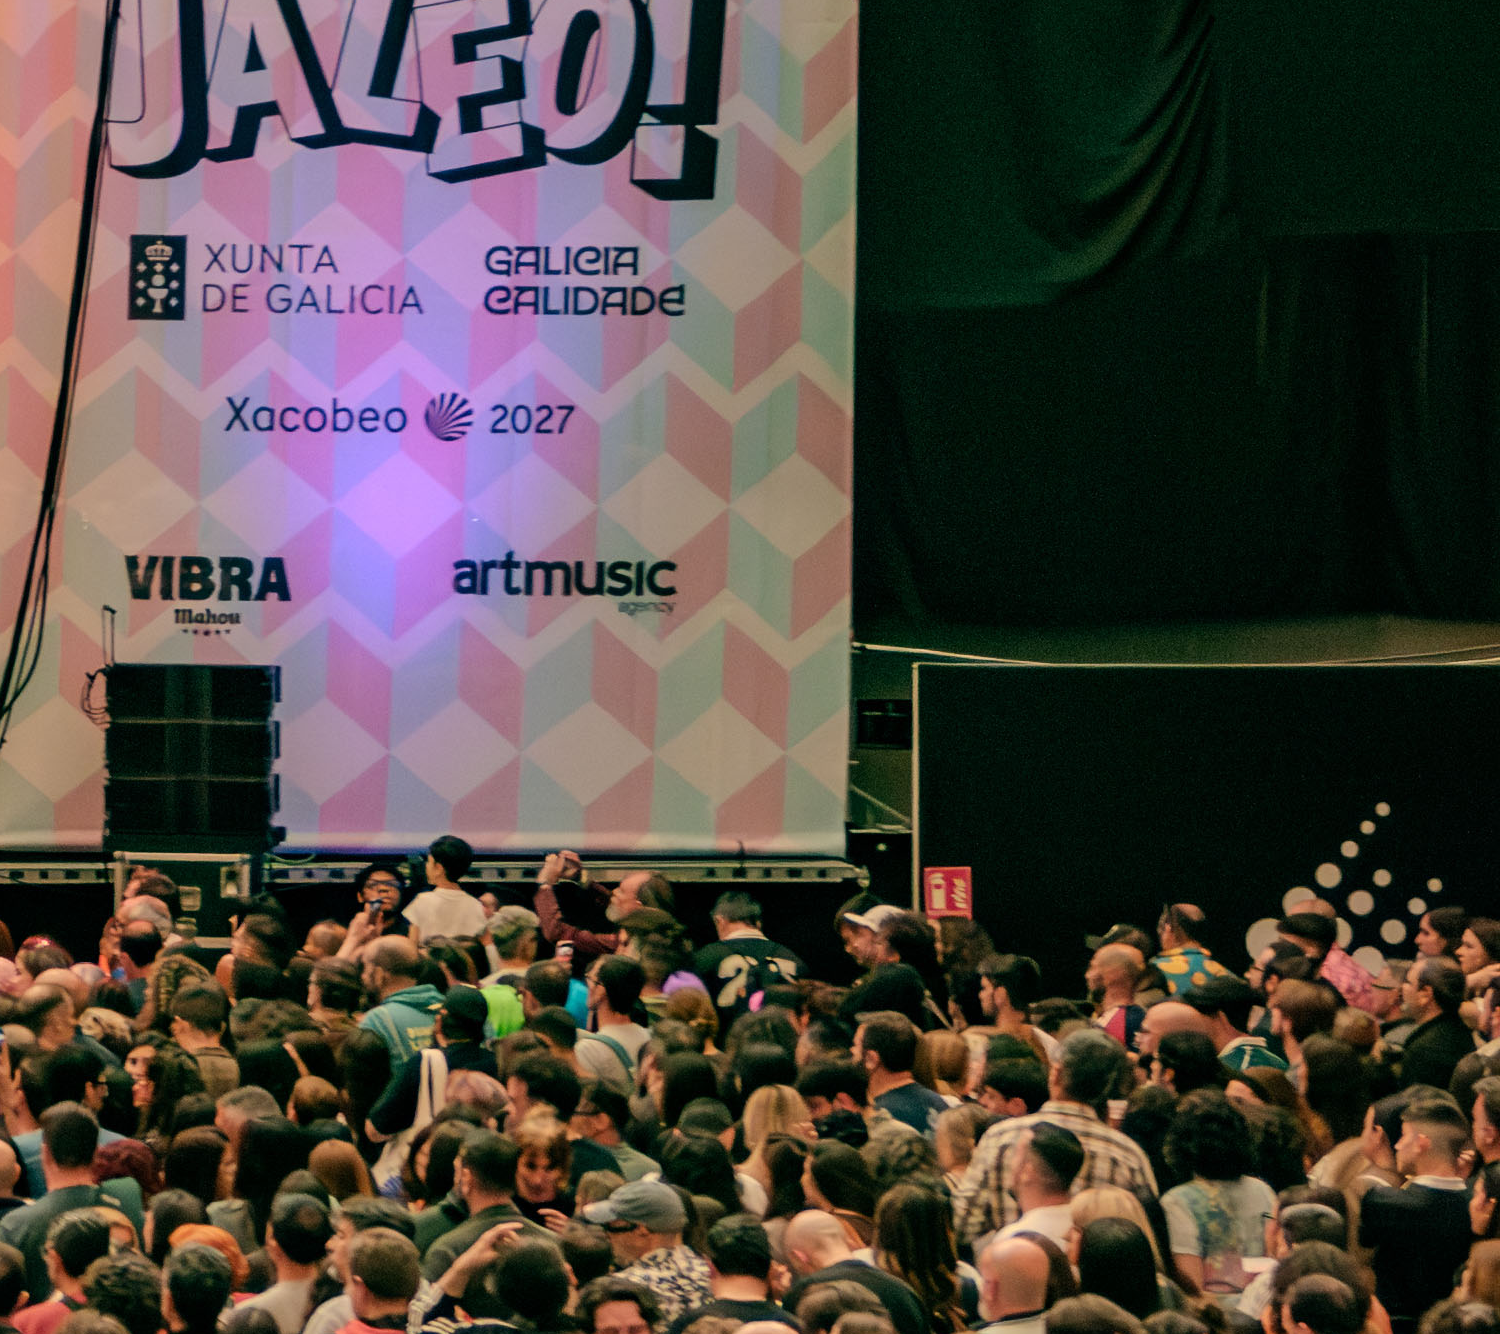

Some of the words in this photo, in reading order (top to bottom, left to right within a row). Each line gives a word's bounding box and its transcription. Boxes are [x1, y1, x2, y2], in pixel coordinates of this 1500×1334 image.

[203, 243, 340, 275] XUNTA
[485, 246, 640, 276] GALICIA
[202, 283, 251, 315] DE
[266, 283, 425, 316] GALICIA
[484, 283, 687, 316] CALIDADE
[224, 397, 408, 434] Xacobeo
[490, 404, 575, 434] 2027
[125, 555, 291, 601] VIBRA
[452, 550, 678, 597] artmusic
[175, 608, 241, 624] Mahou
